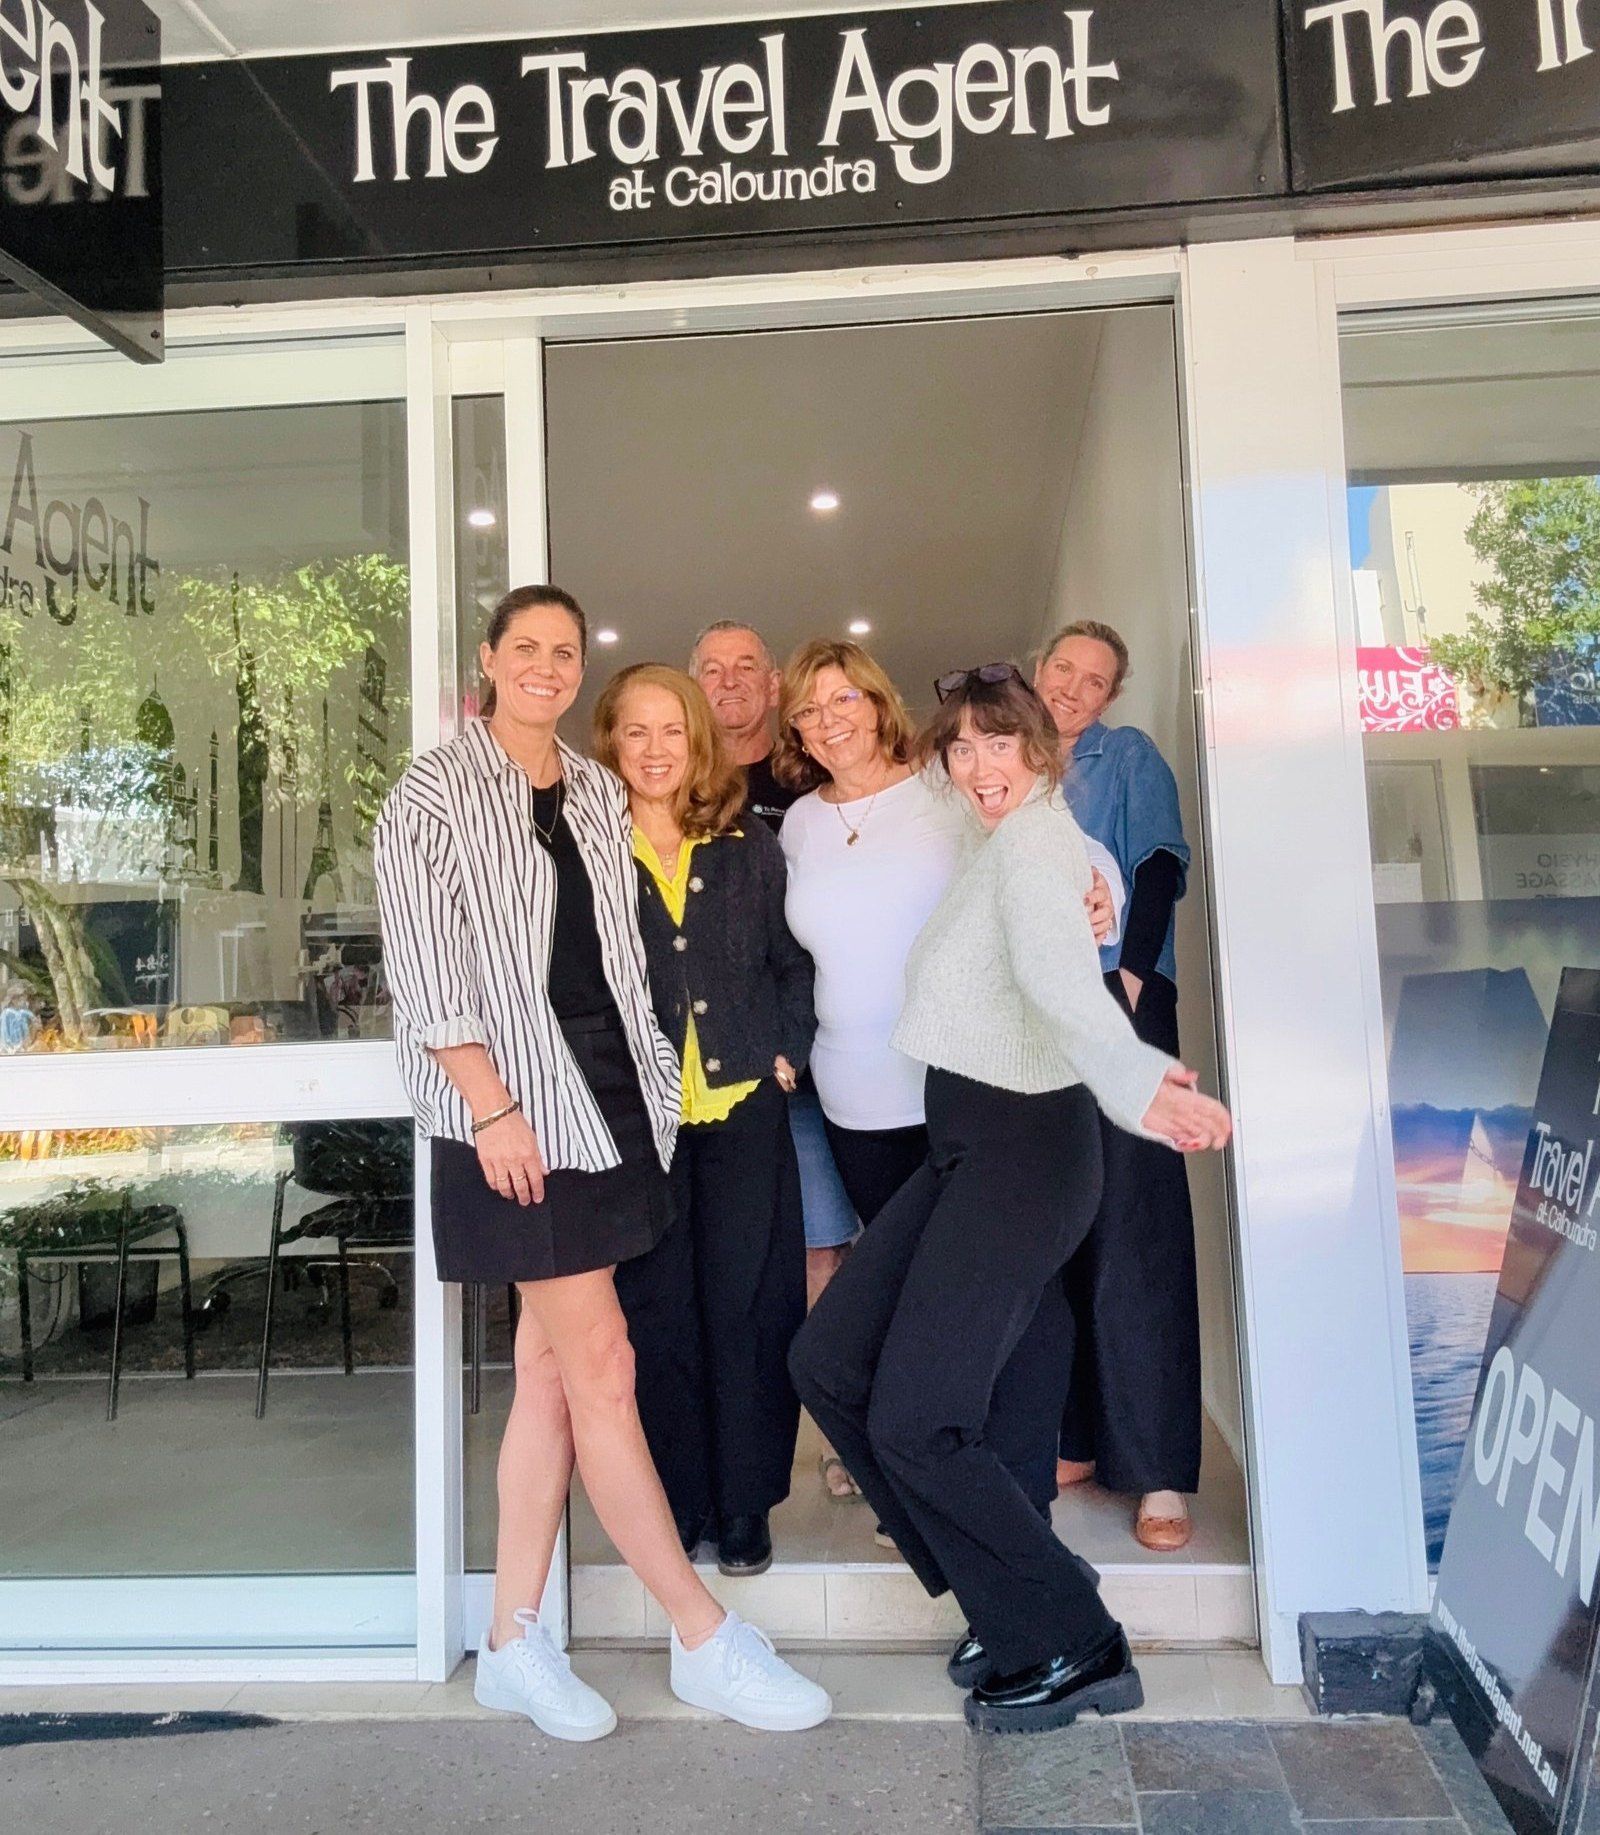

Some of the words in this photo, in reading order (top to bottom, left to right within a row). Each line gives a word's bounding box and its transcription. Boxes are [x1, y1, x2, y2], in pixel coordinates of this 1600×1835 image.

[330, 57, 499, 182] The
[521, 33, 788, 169] Travel
[817, 10, 1119, 184] Agent
[1305, 0, 1485, 113] The
[609, 170, 655, 210] at
[665, 155, 876, 207] Caloundra
[0, 430, 160, 626] Agent
[1529, 1121, 1594, 1215] Travel
[1536, 1200, 1548, 1225] at
[1548, 1204, 1597, 1251] Caloundra
[1474, 1345, 1600, 1608] OPEN
[1437, 1598, 1559, 1798] www.thetravelagent.net.au
